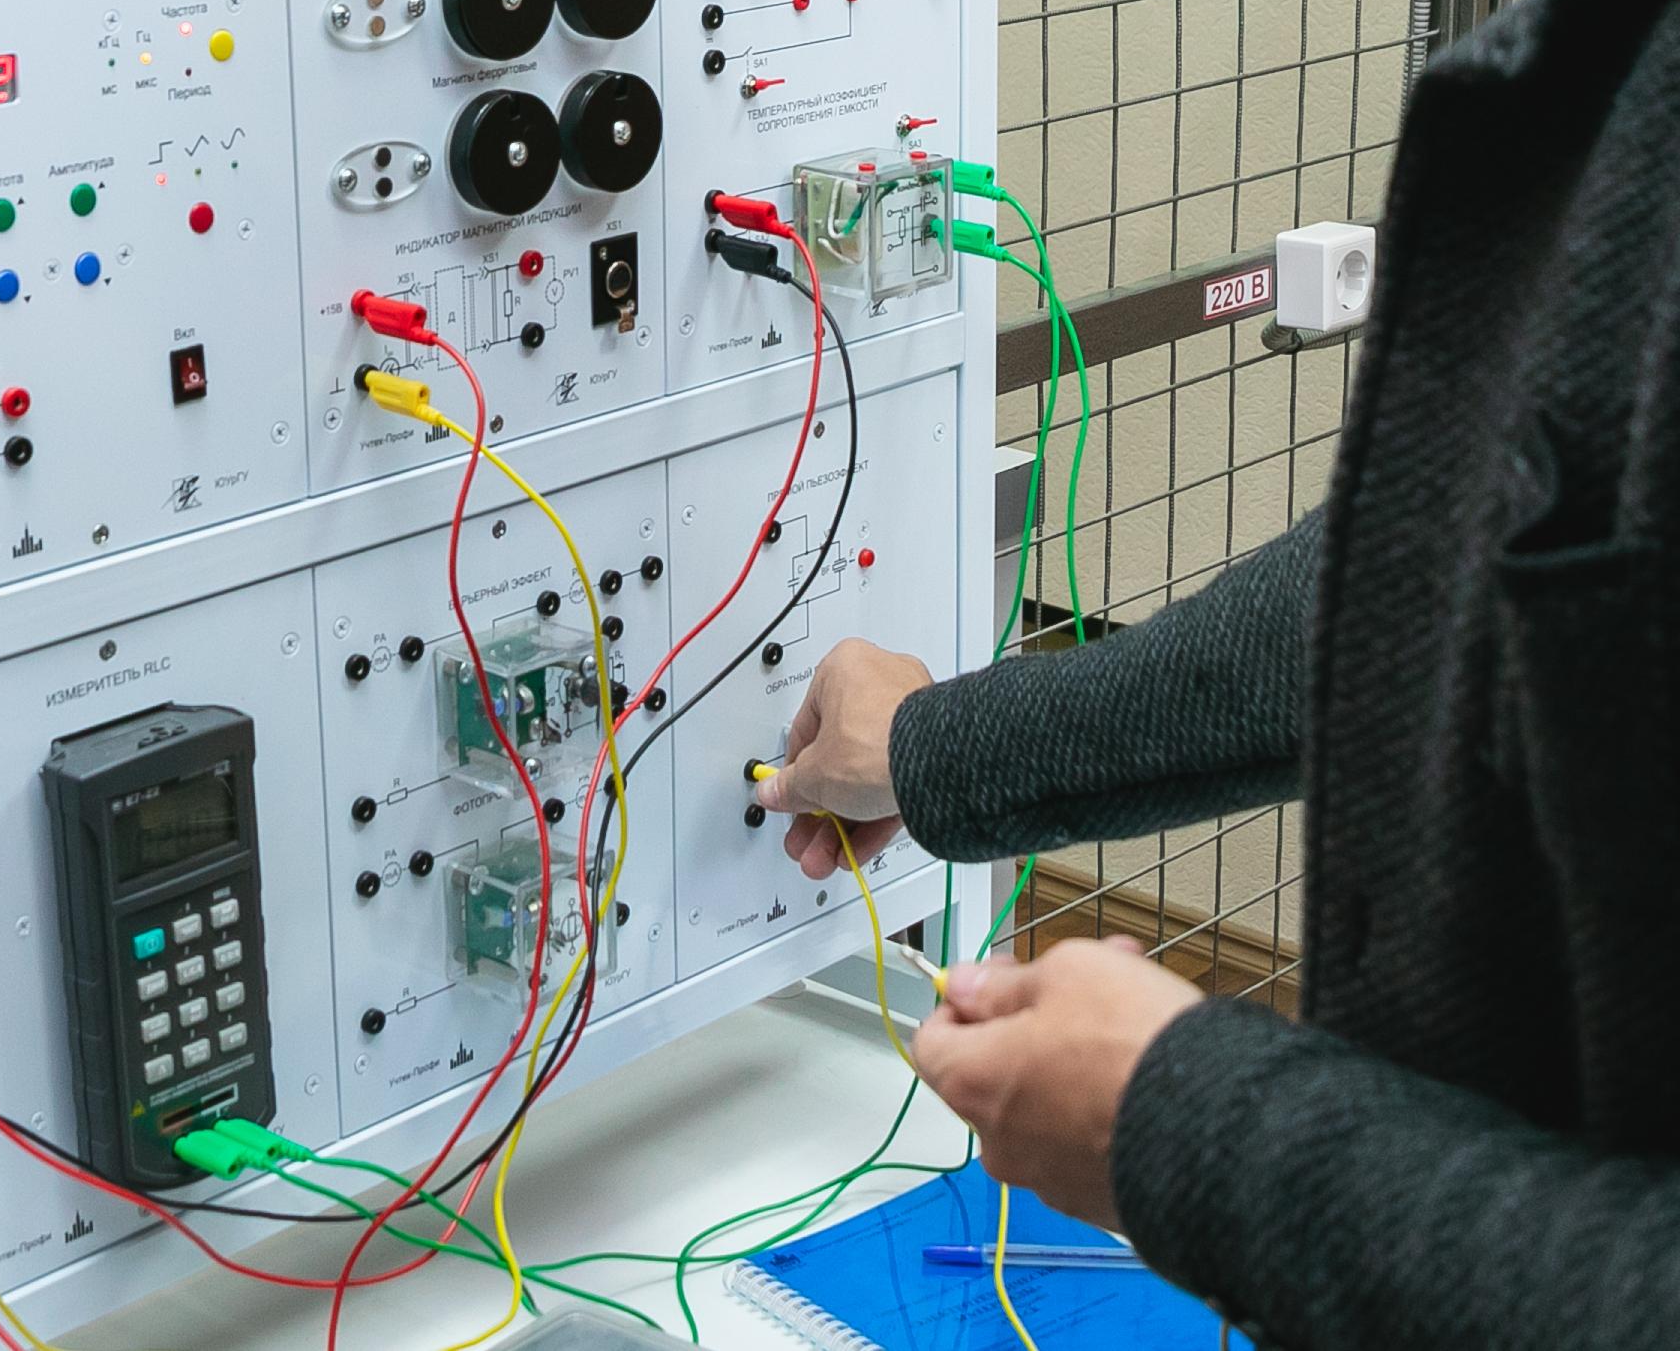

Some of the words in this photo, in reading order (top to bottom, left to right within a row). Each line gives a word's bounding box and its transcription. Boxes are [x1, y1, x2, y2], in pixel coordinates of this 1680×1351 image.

[161, 2, 208, 19] Частота
[432, 73, 475, 89] Магниты
[476, 60, 538, 84] ферритовые
[168, 83, 212, 102] Период
[747, 94, 822, 121] ТЕМПЕРАТУРНЫЙ
[823, 82, 888, 105] КОЭФФИЦИЕНТ
[757, 107, 833, 134] СОПРОТИВЛЕНИЯ
[839, 98, 879, 117] ЕМКОСТИ
[48, 154, 115, 179] Амплитуда
[395, 230, 460, 256] ИНДИКАТОР
[462, 214, 525, 240] МАГНИТНОЙ
[526, 203, 583, 225] ИНДУКЦИИ
[1211, 280, 1245, 312] 220
[173, 328, 196, 341] Вкл
[806, 460, 869, 490] ПЬЕЗОЭФЕКТ
[448, 581, 509, 611] БРЬЕРНЫЙ
[511, 566, 552, 591] ЭФФЕКТ
[45, 669, 140, 708] ИЗМЕРИТЕЛЬ
[143, 657, 171, 675] RLC
[765, 668, 813, 696] ОБРАТНЫЙ
